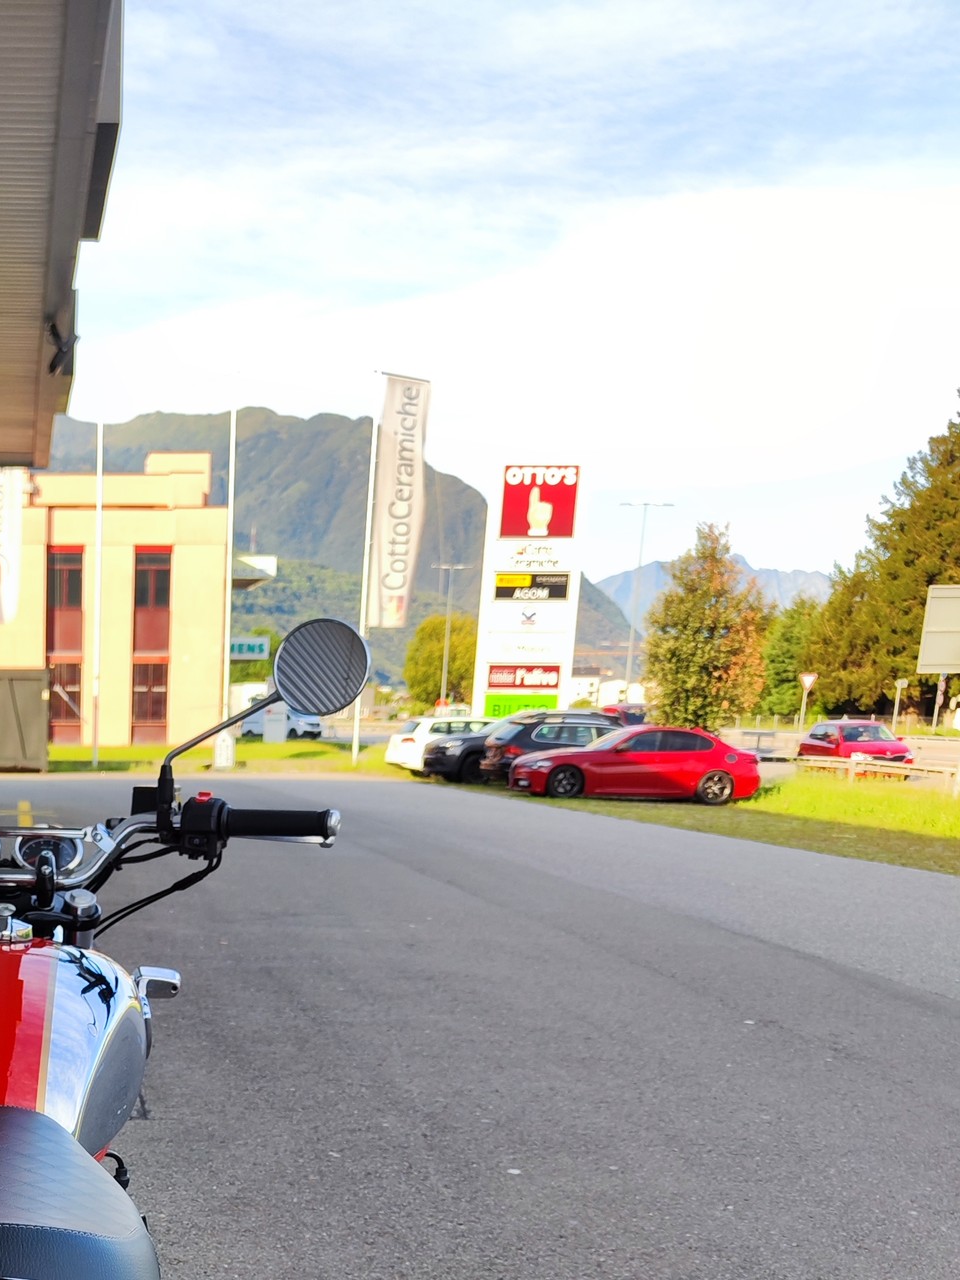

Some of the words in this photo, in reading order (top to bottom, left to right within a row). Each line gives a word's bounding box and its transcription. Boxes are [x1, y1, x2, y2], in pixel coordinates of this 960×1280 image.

[505, 467, 578, 486] OTTO'S
[381, 384, 421, 591] CottoCeramiche
[512, 586, 550, 600] AGOM
